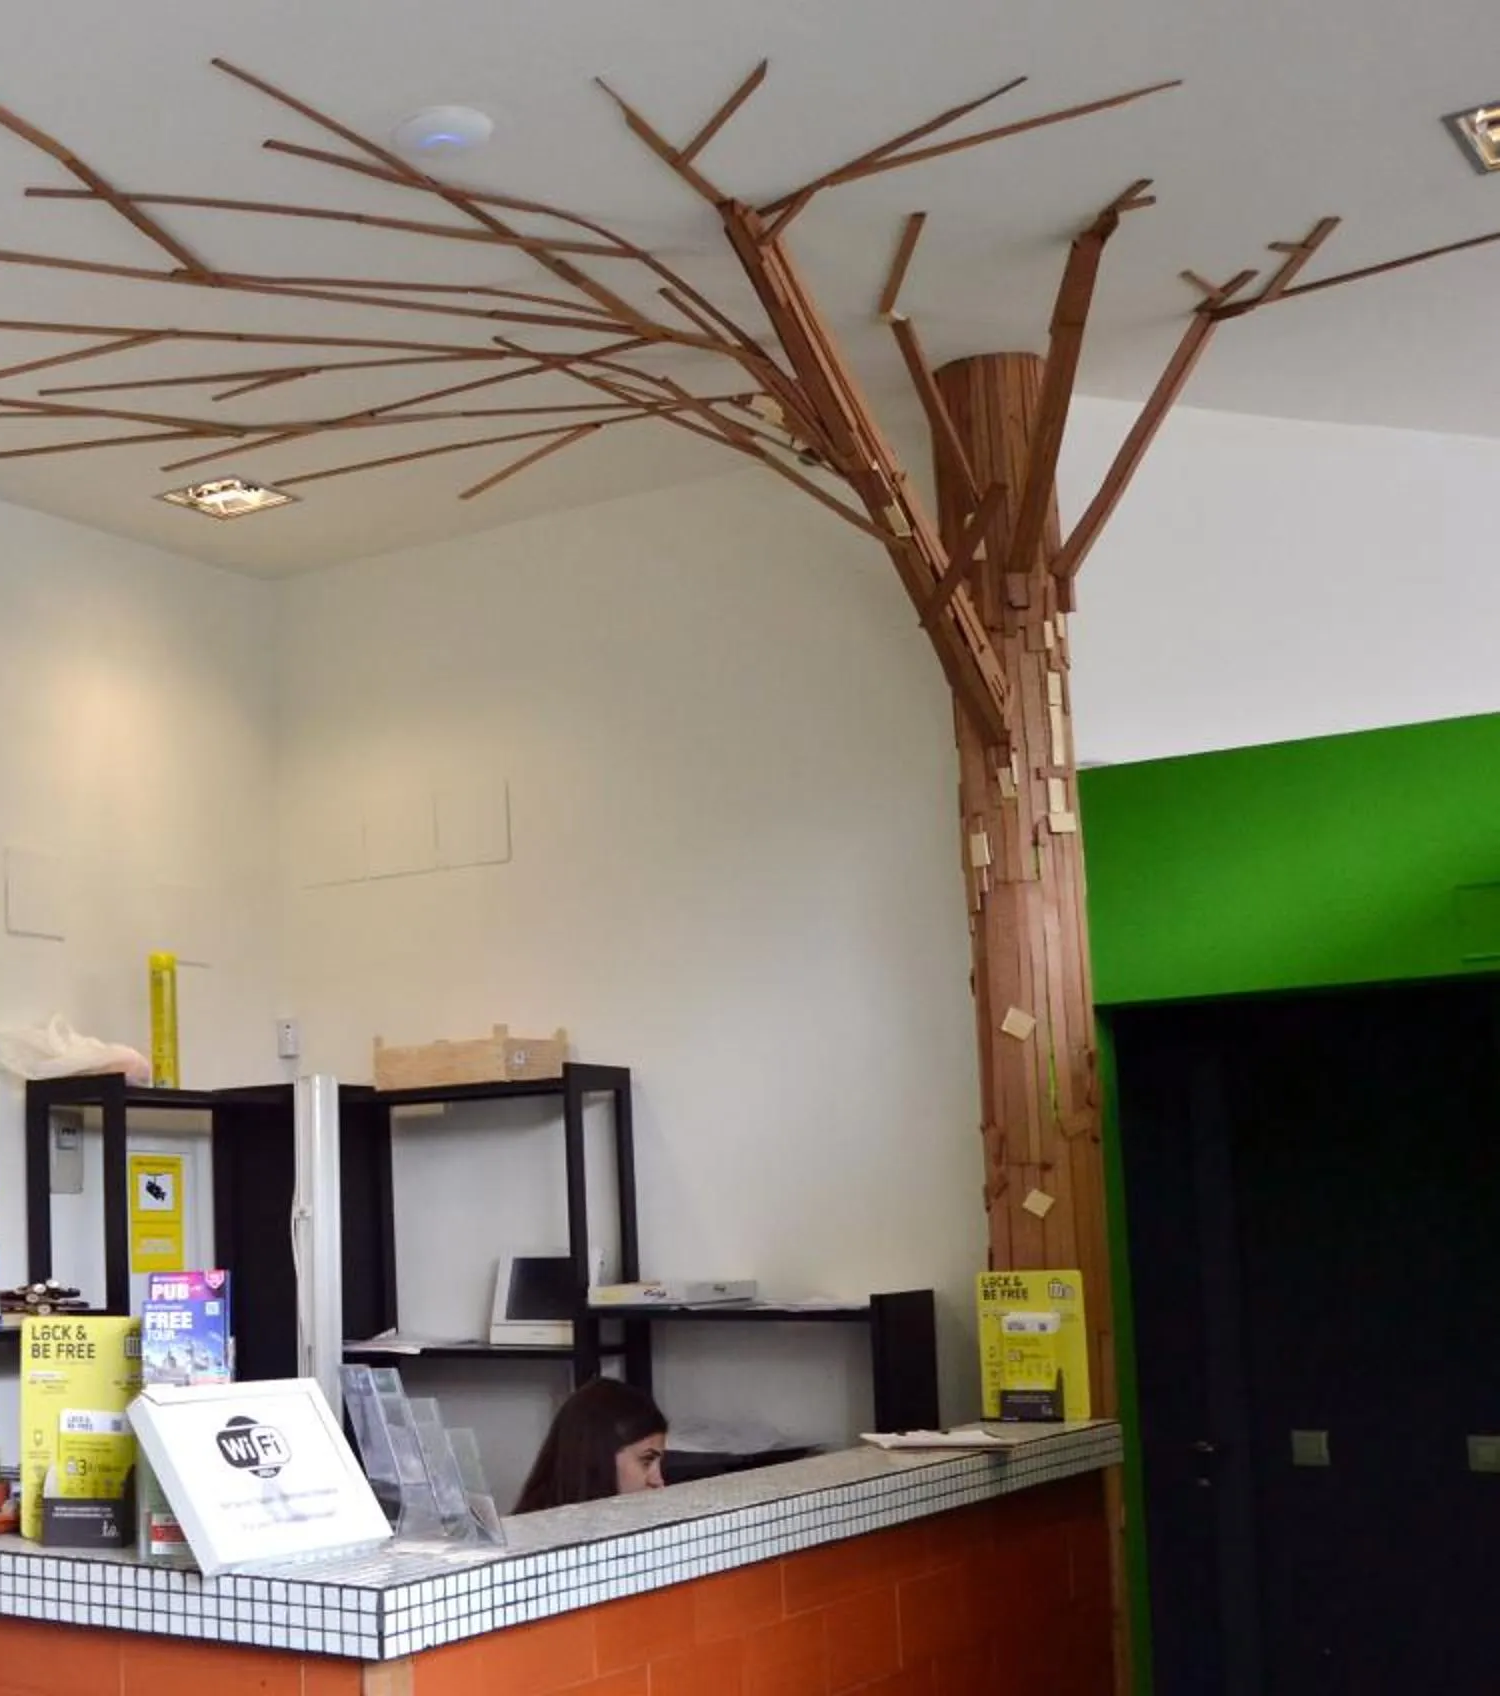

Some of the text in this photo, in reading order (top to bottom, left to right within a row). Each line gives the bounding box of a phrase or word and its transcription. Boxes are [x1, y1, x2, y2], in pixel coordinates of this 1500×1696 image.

[145, 1311, 193, 1329] FREE
[31, 1325, 88, 1341] LOCK &
[31, 1343, 97, 1359] BE FREE
